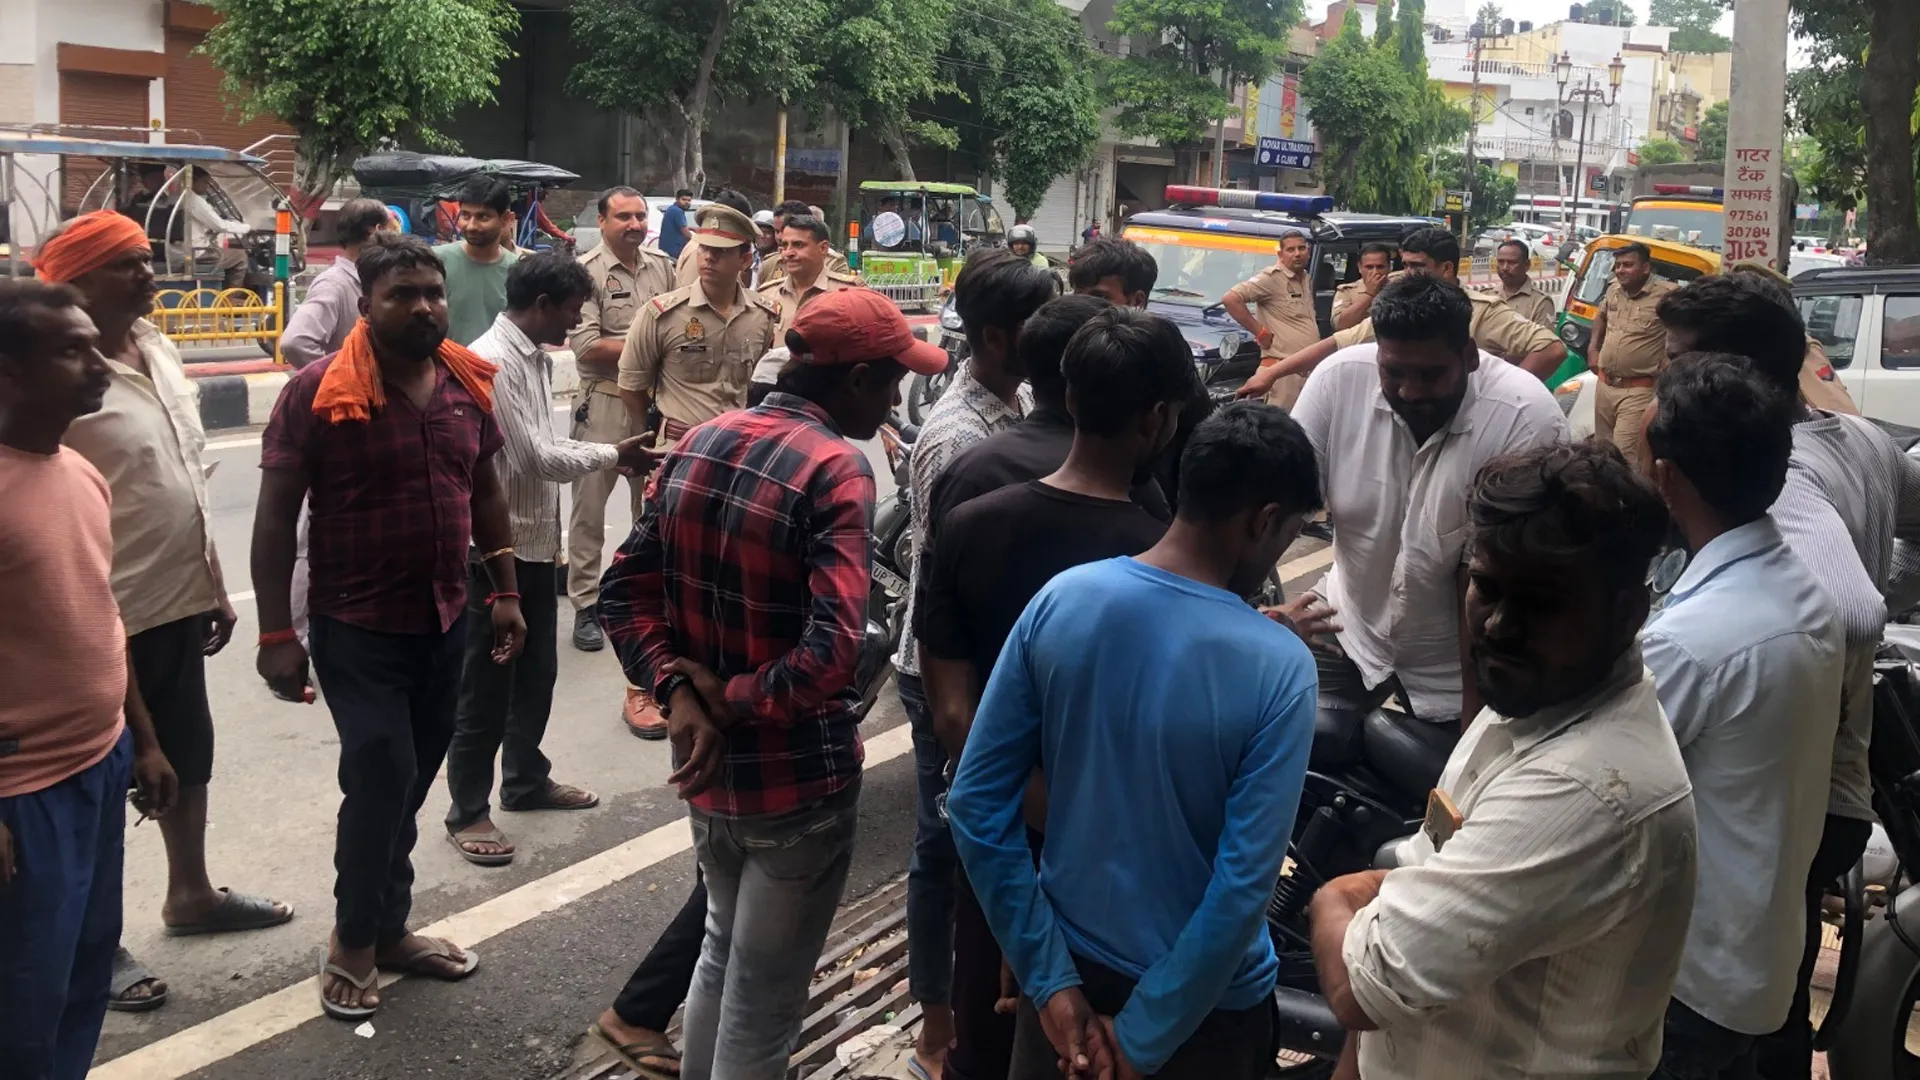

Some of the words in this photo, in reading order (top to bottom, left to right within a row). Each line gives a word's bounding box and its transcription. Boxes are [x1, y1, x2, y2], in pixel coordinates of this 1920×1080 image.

[1281, 141, 1313, 154] ULTRASOUND
[1281, 155, 1299, 165] CLINIC
[1736, 148, 1771, 162] गटर
[1737, 166, 1765, 182] टैंक
[1730, 186, 1772, 203] सफाई
[1729, 210, 1768, 221] 97561
[1727, 226, 1770, 238] 30784
[874, 568, 887, 580] UP
